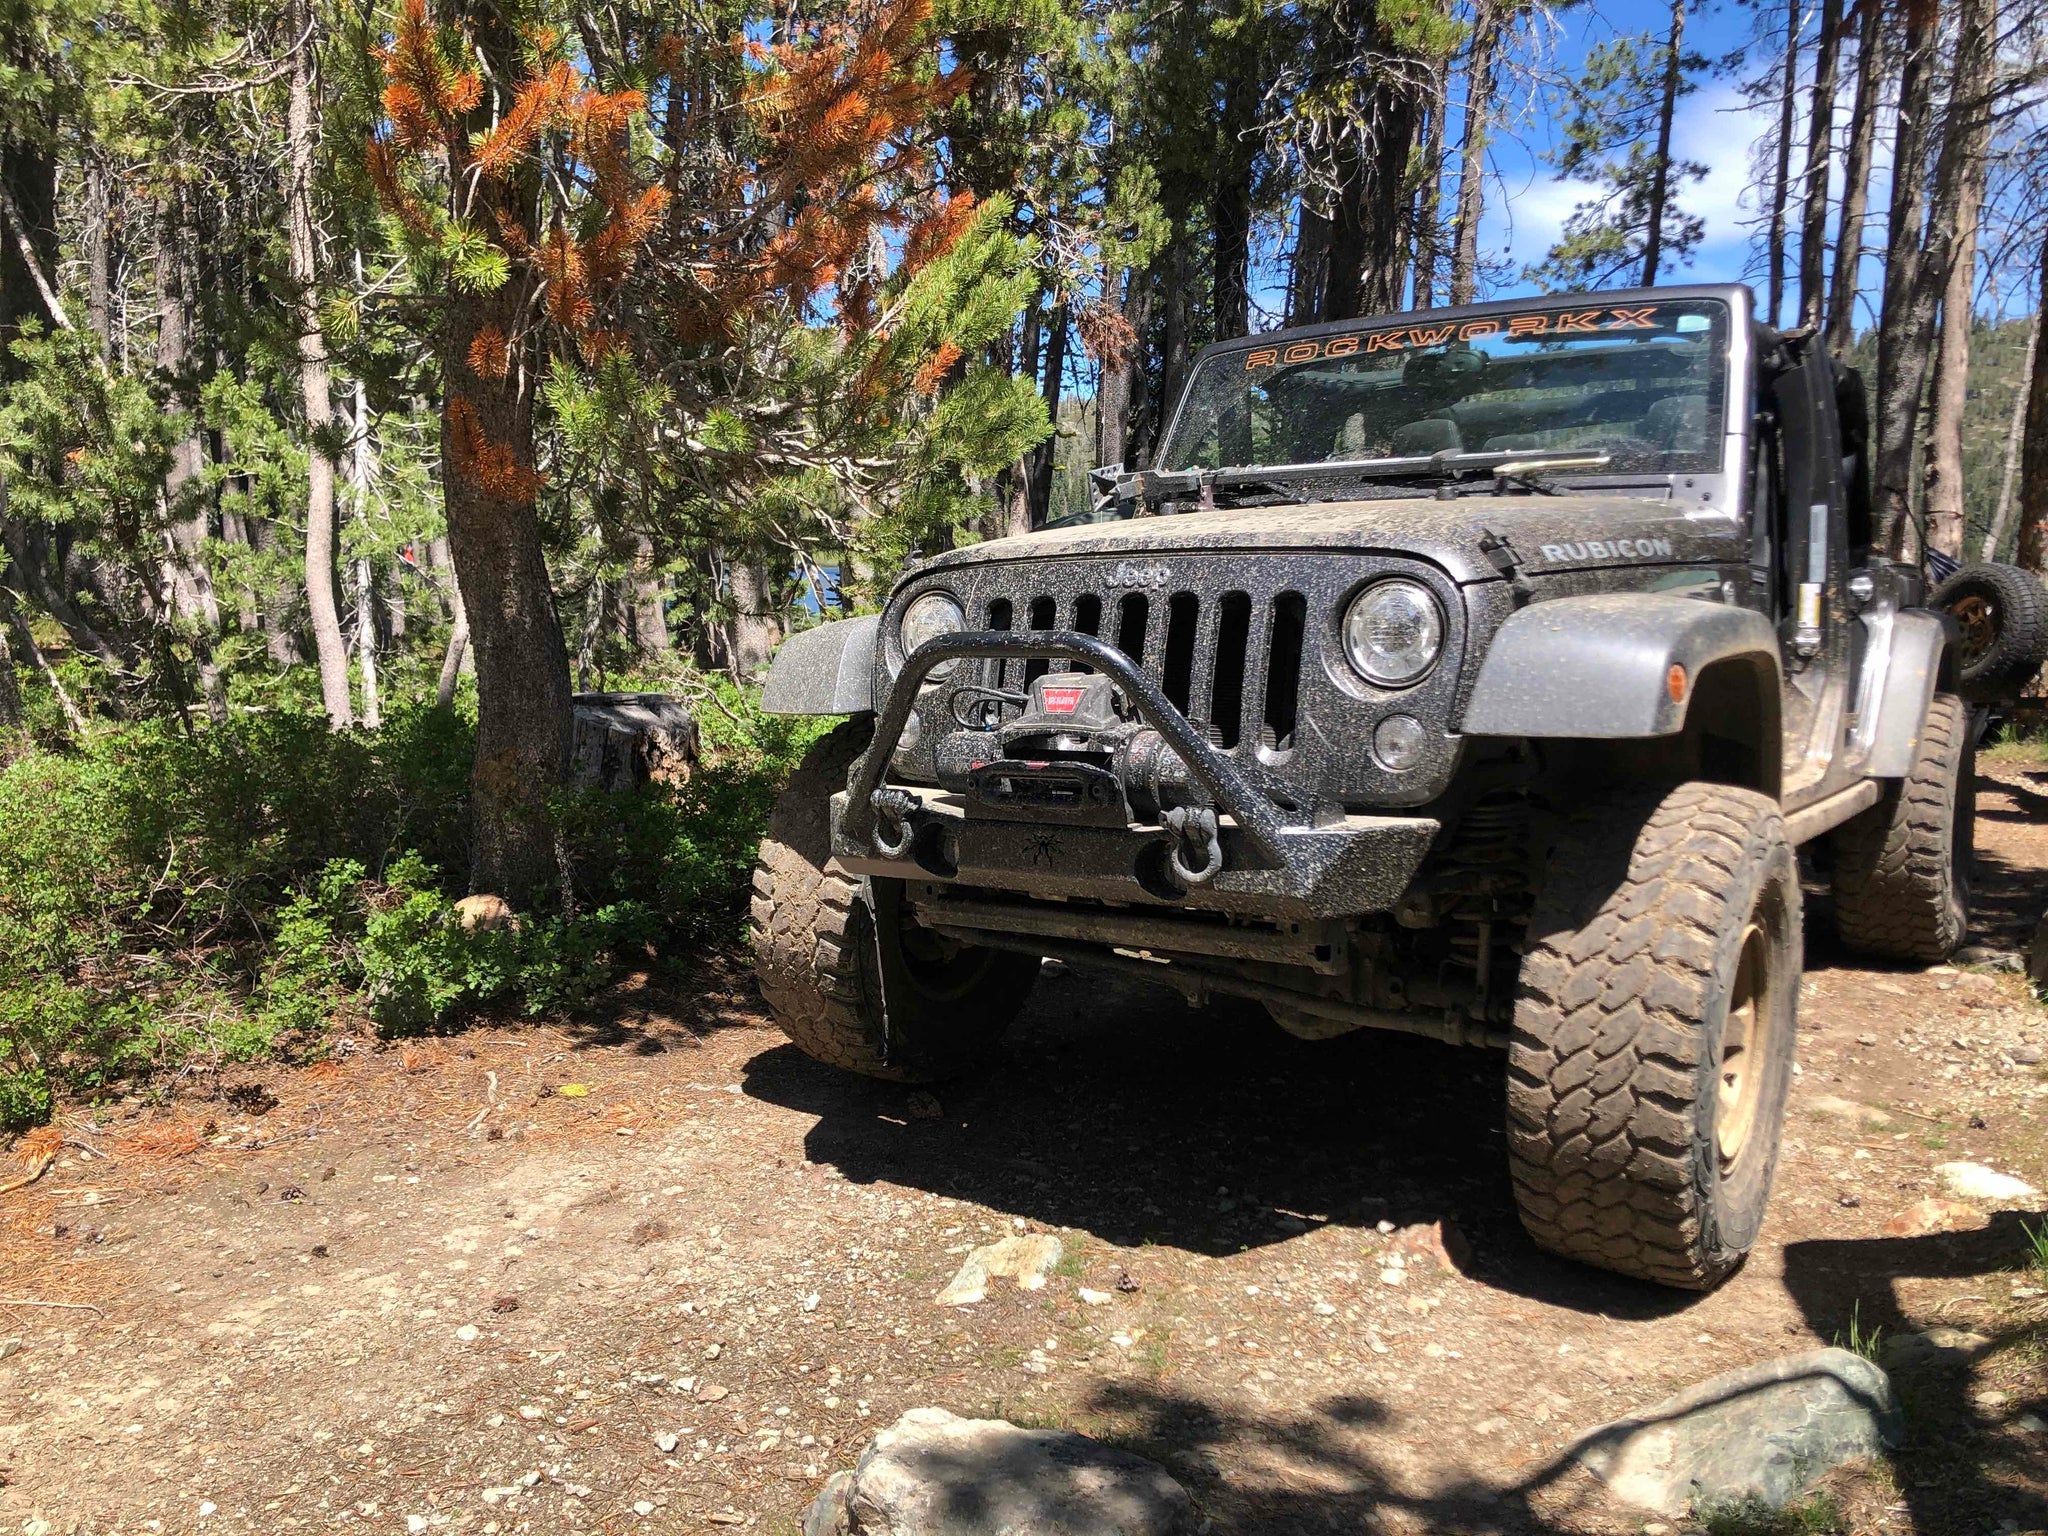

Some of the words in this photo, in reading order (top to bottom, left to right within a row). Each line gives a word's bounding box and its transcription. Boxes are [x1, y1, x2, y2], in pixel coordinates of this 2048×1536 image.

[1245, 307, 1658, 370] ROCKWORKX
[1540, 538, 1673, 561] RUBICON
[1105, 563, 1171, 591] Jeep
